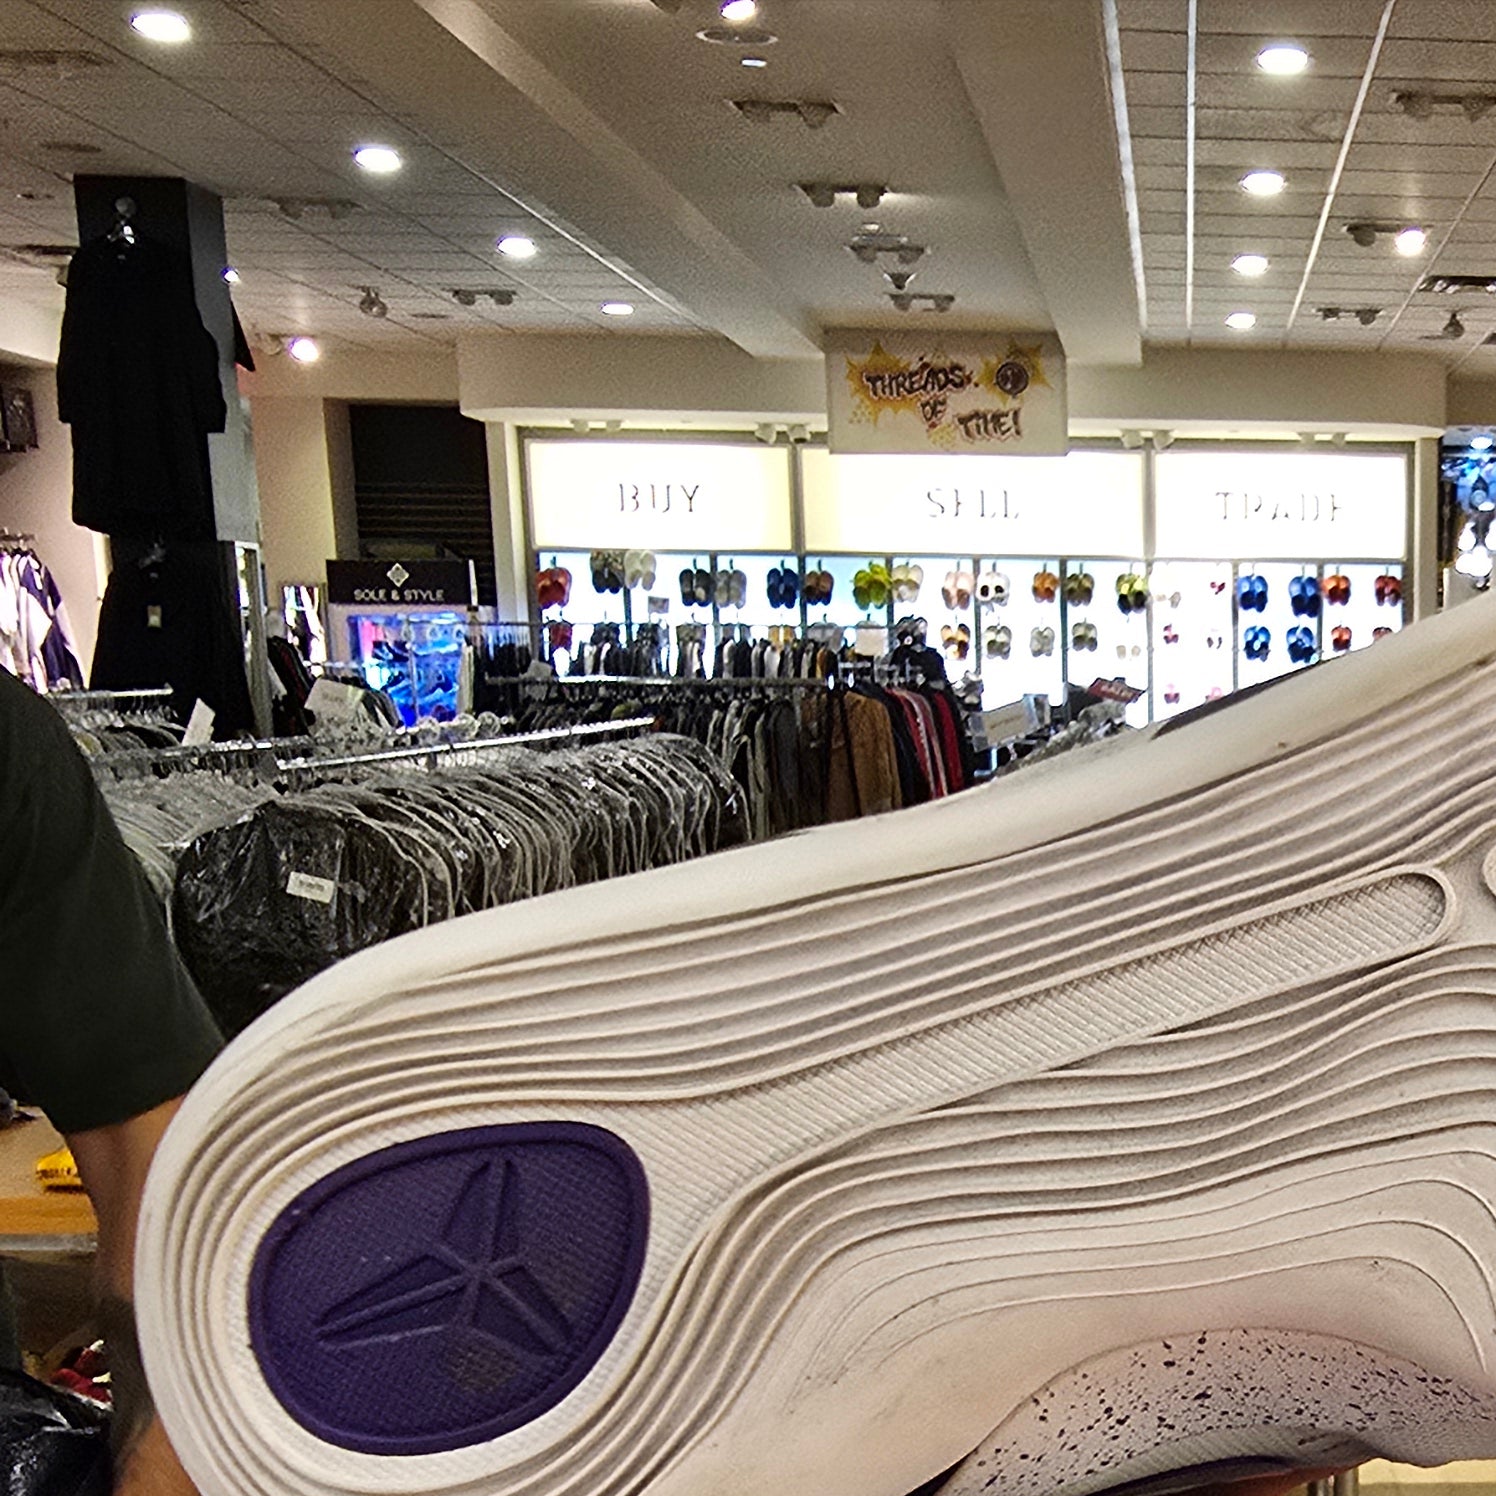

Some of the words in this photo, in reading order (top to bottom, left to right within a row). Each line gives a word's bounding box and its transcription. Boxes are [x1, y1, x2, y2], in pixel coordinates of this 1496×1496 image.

[618, 483, 700, 513] BUY
[353, 588, 387, 601] SOLE
[404, 588, 445, 602] STYLE
